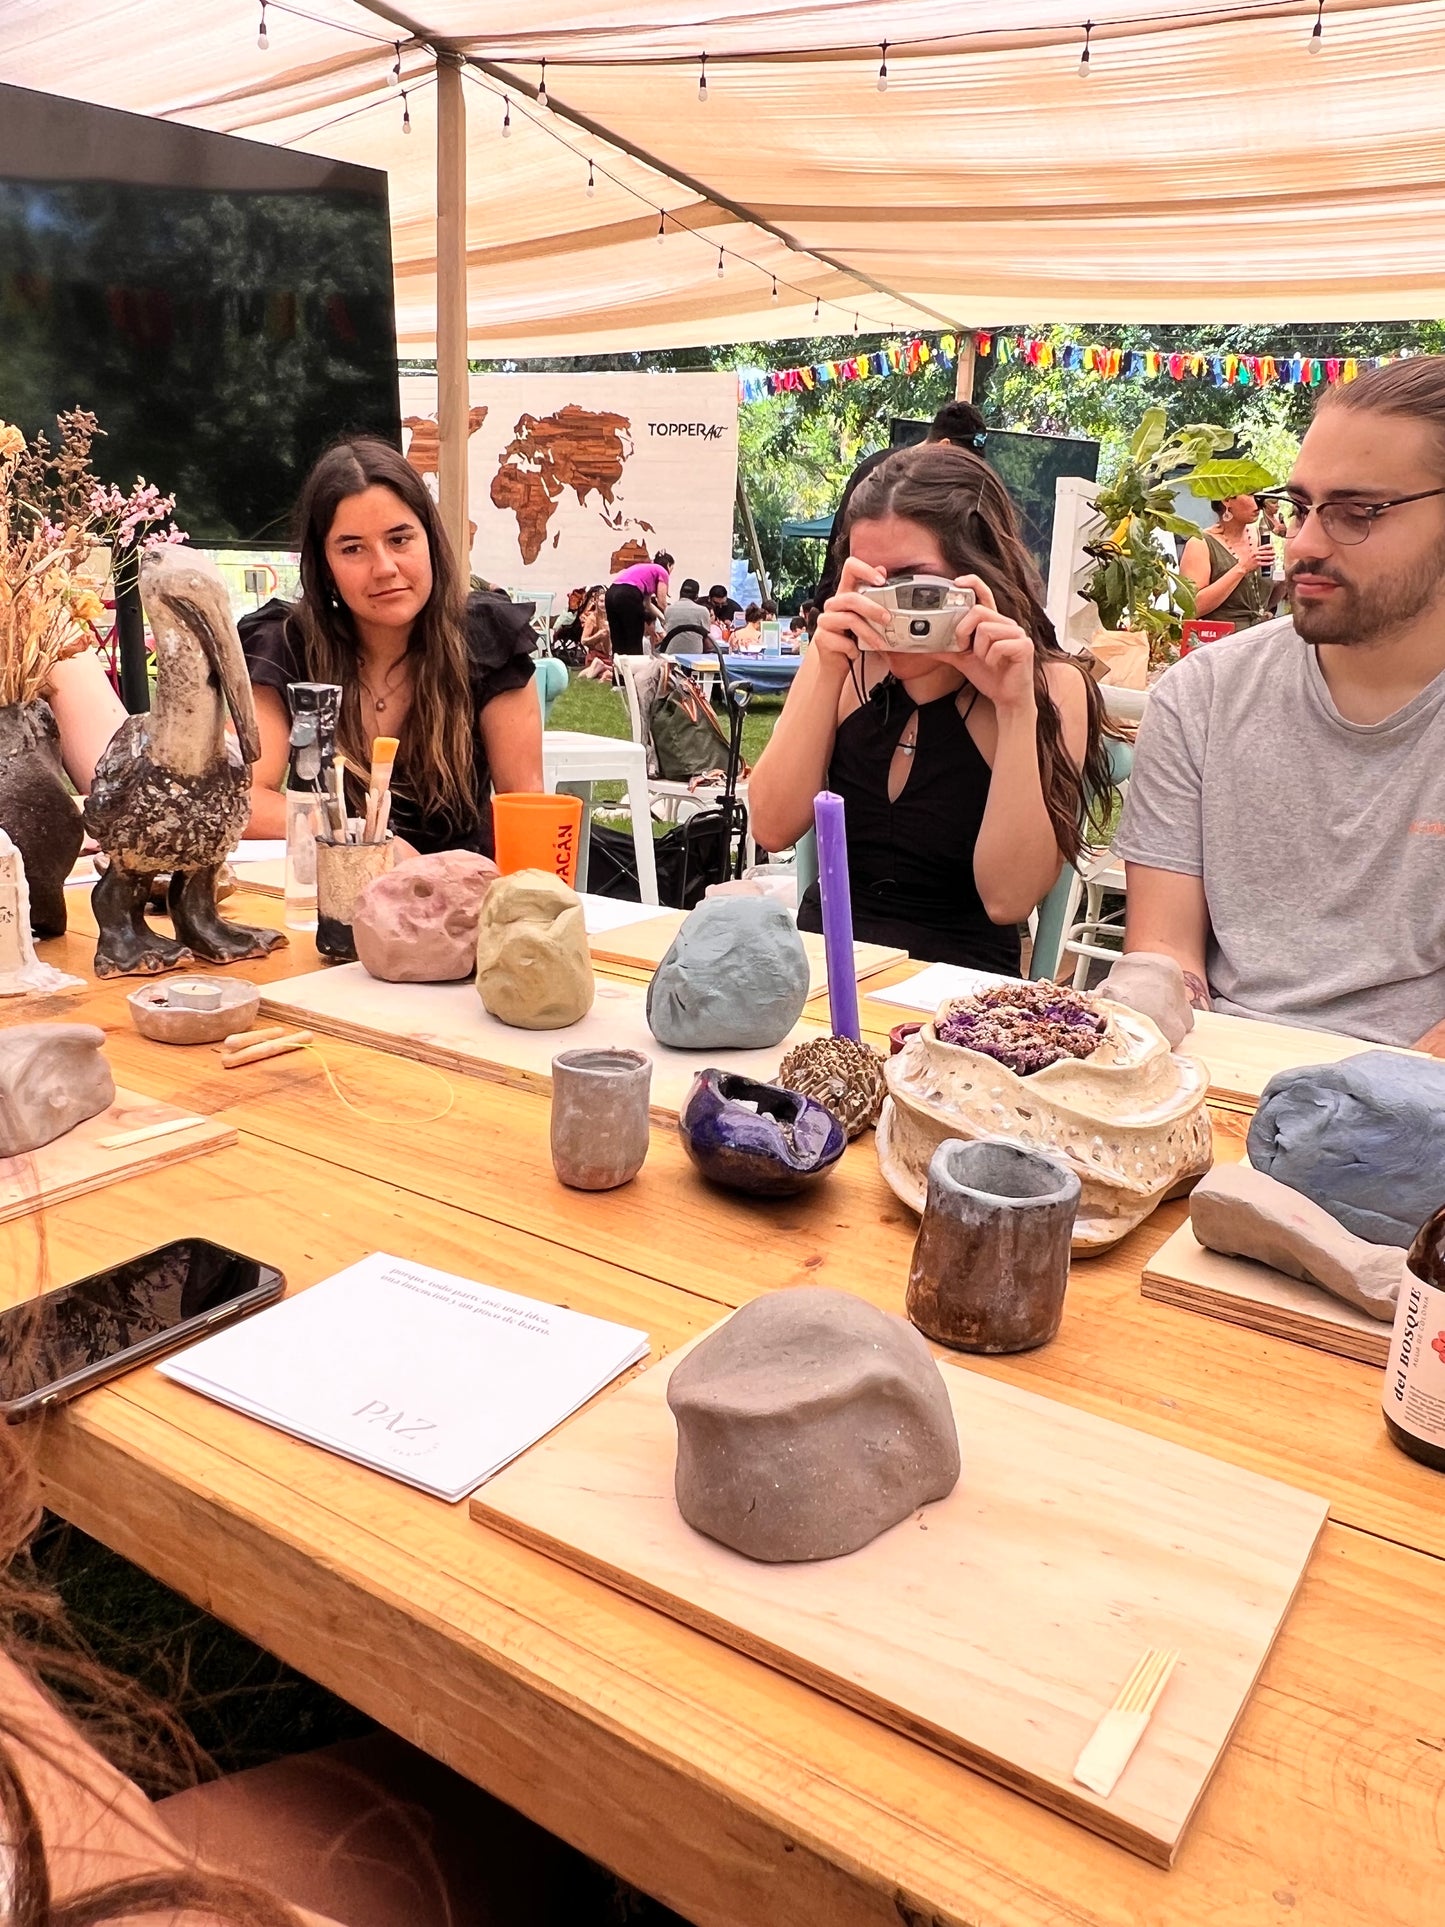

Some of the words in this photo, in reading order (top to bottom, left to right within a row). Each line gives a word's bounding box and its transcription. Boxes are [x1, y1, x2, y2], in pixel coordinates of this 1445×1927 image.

[380, 1275, 401, 1284] una
[452, 1289, 481, 1301] parte
[502, 1305, 524, 1316] una
[1399, 1286, 1422, 1368] BOSQUE
[1394, 1369, 1408, 1402] del
[352, 1400, 438, 1440] PAZ
